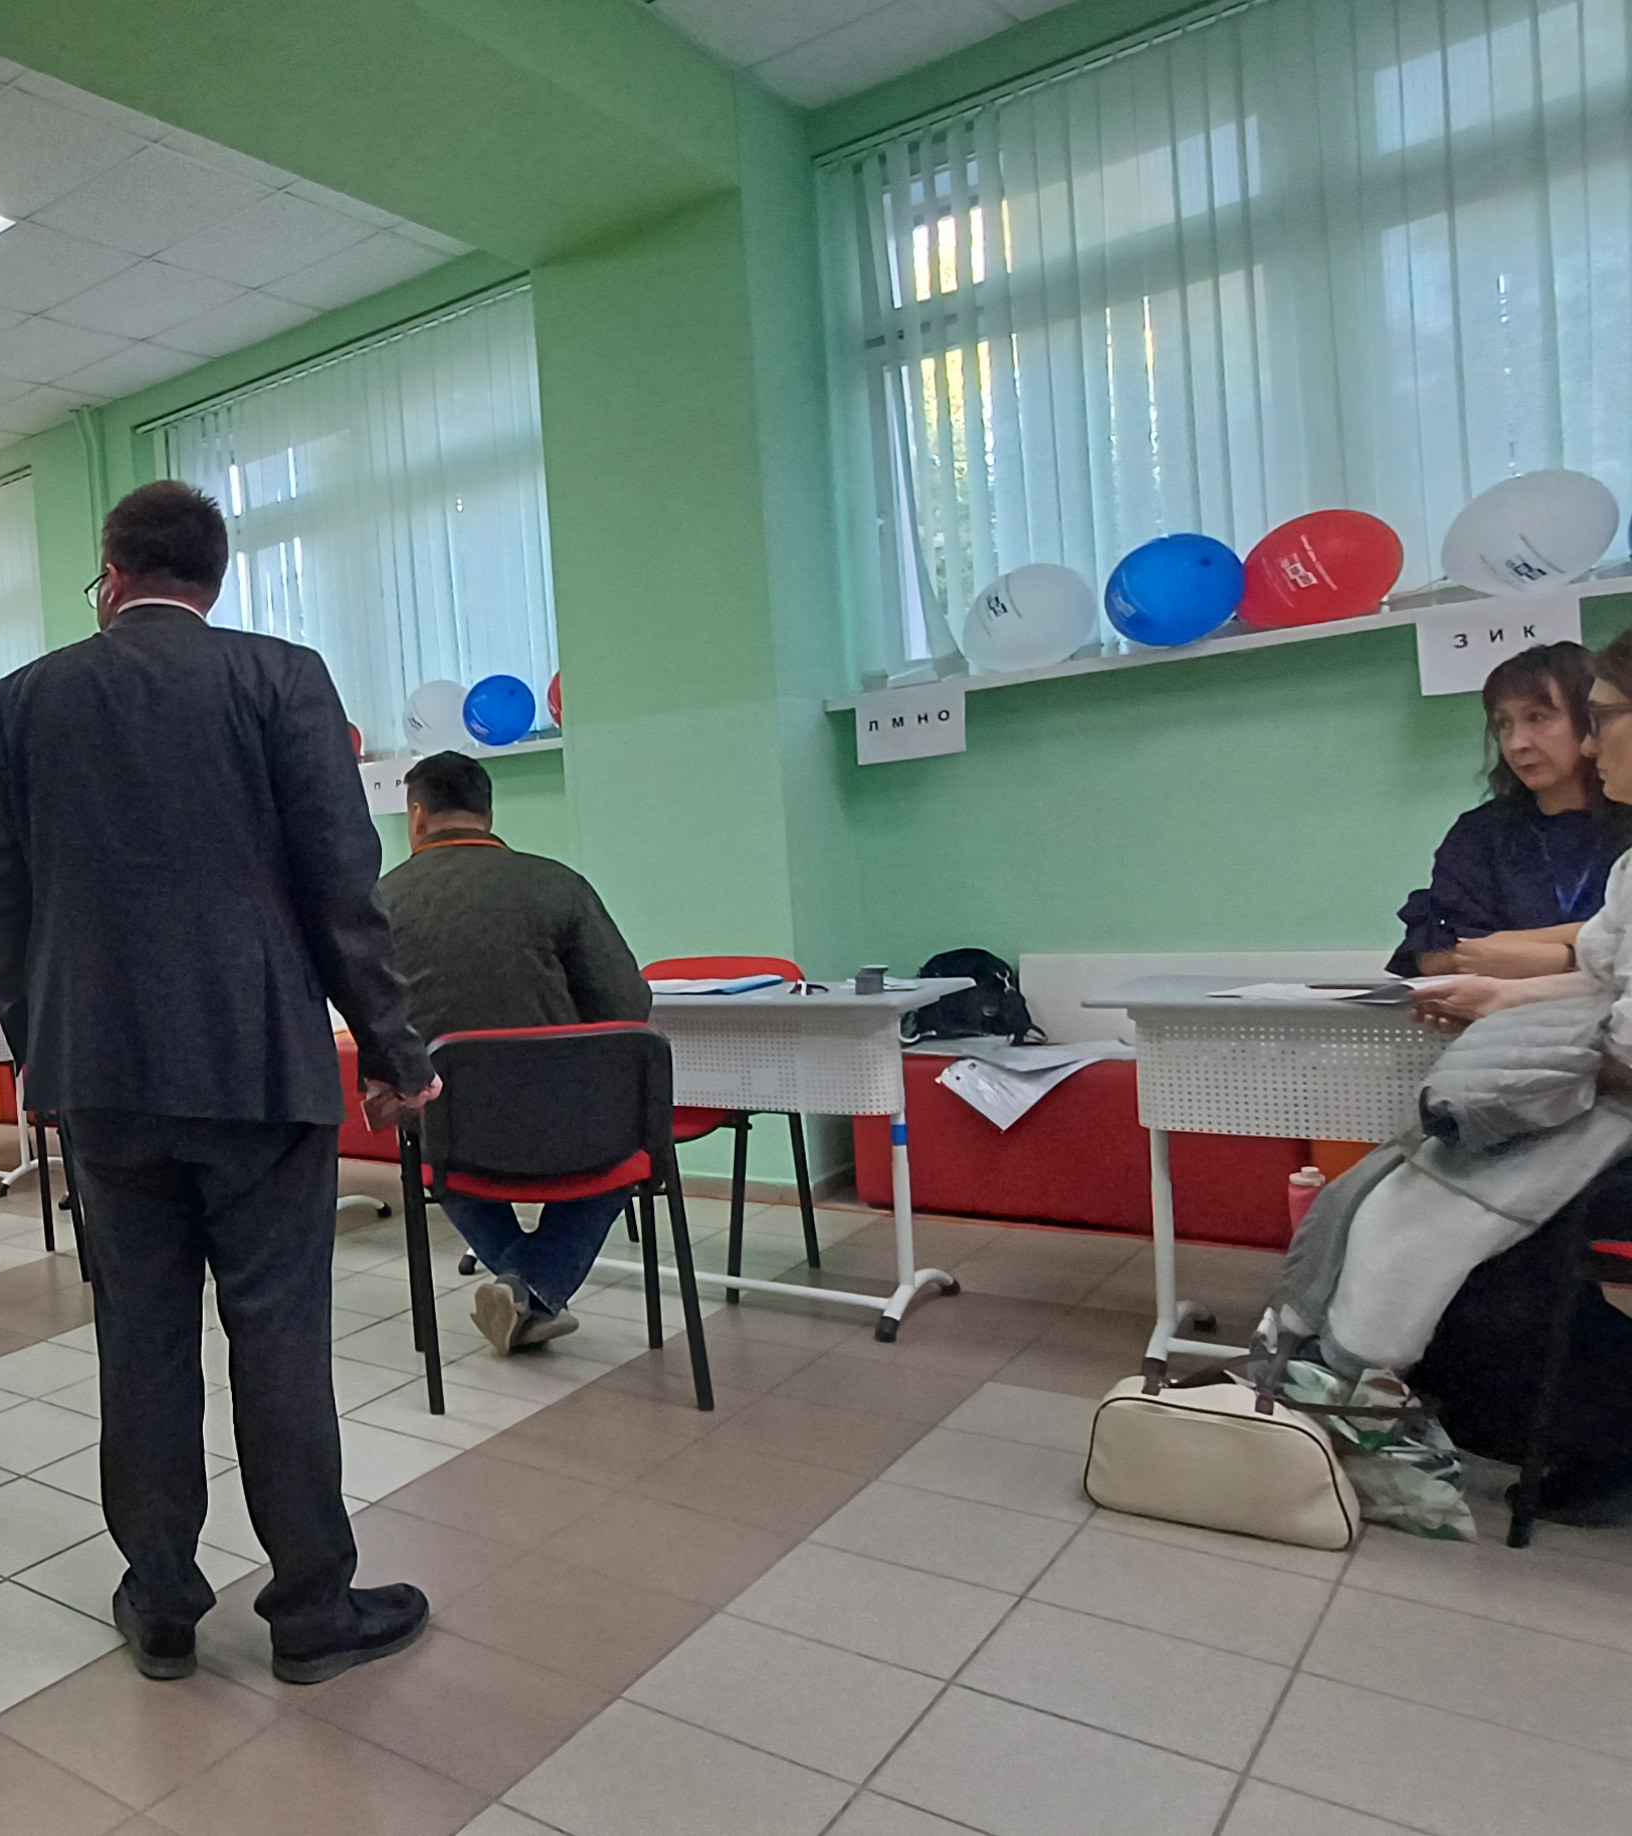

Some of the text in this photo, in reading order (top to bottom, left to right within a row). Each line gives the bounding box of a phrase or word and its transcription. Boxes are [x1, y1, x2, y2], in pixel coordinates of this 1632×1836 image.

[1453, 624, 1536, 649] З И К
[891, 716, 905, 729] М
[917, 713, 929, 725] Н
[937, 709, 951, 722] О
